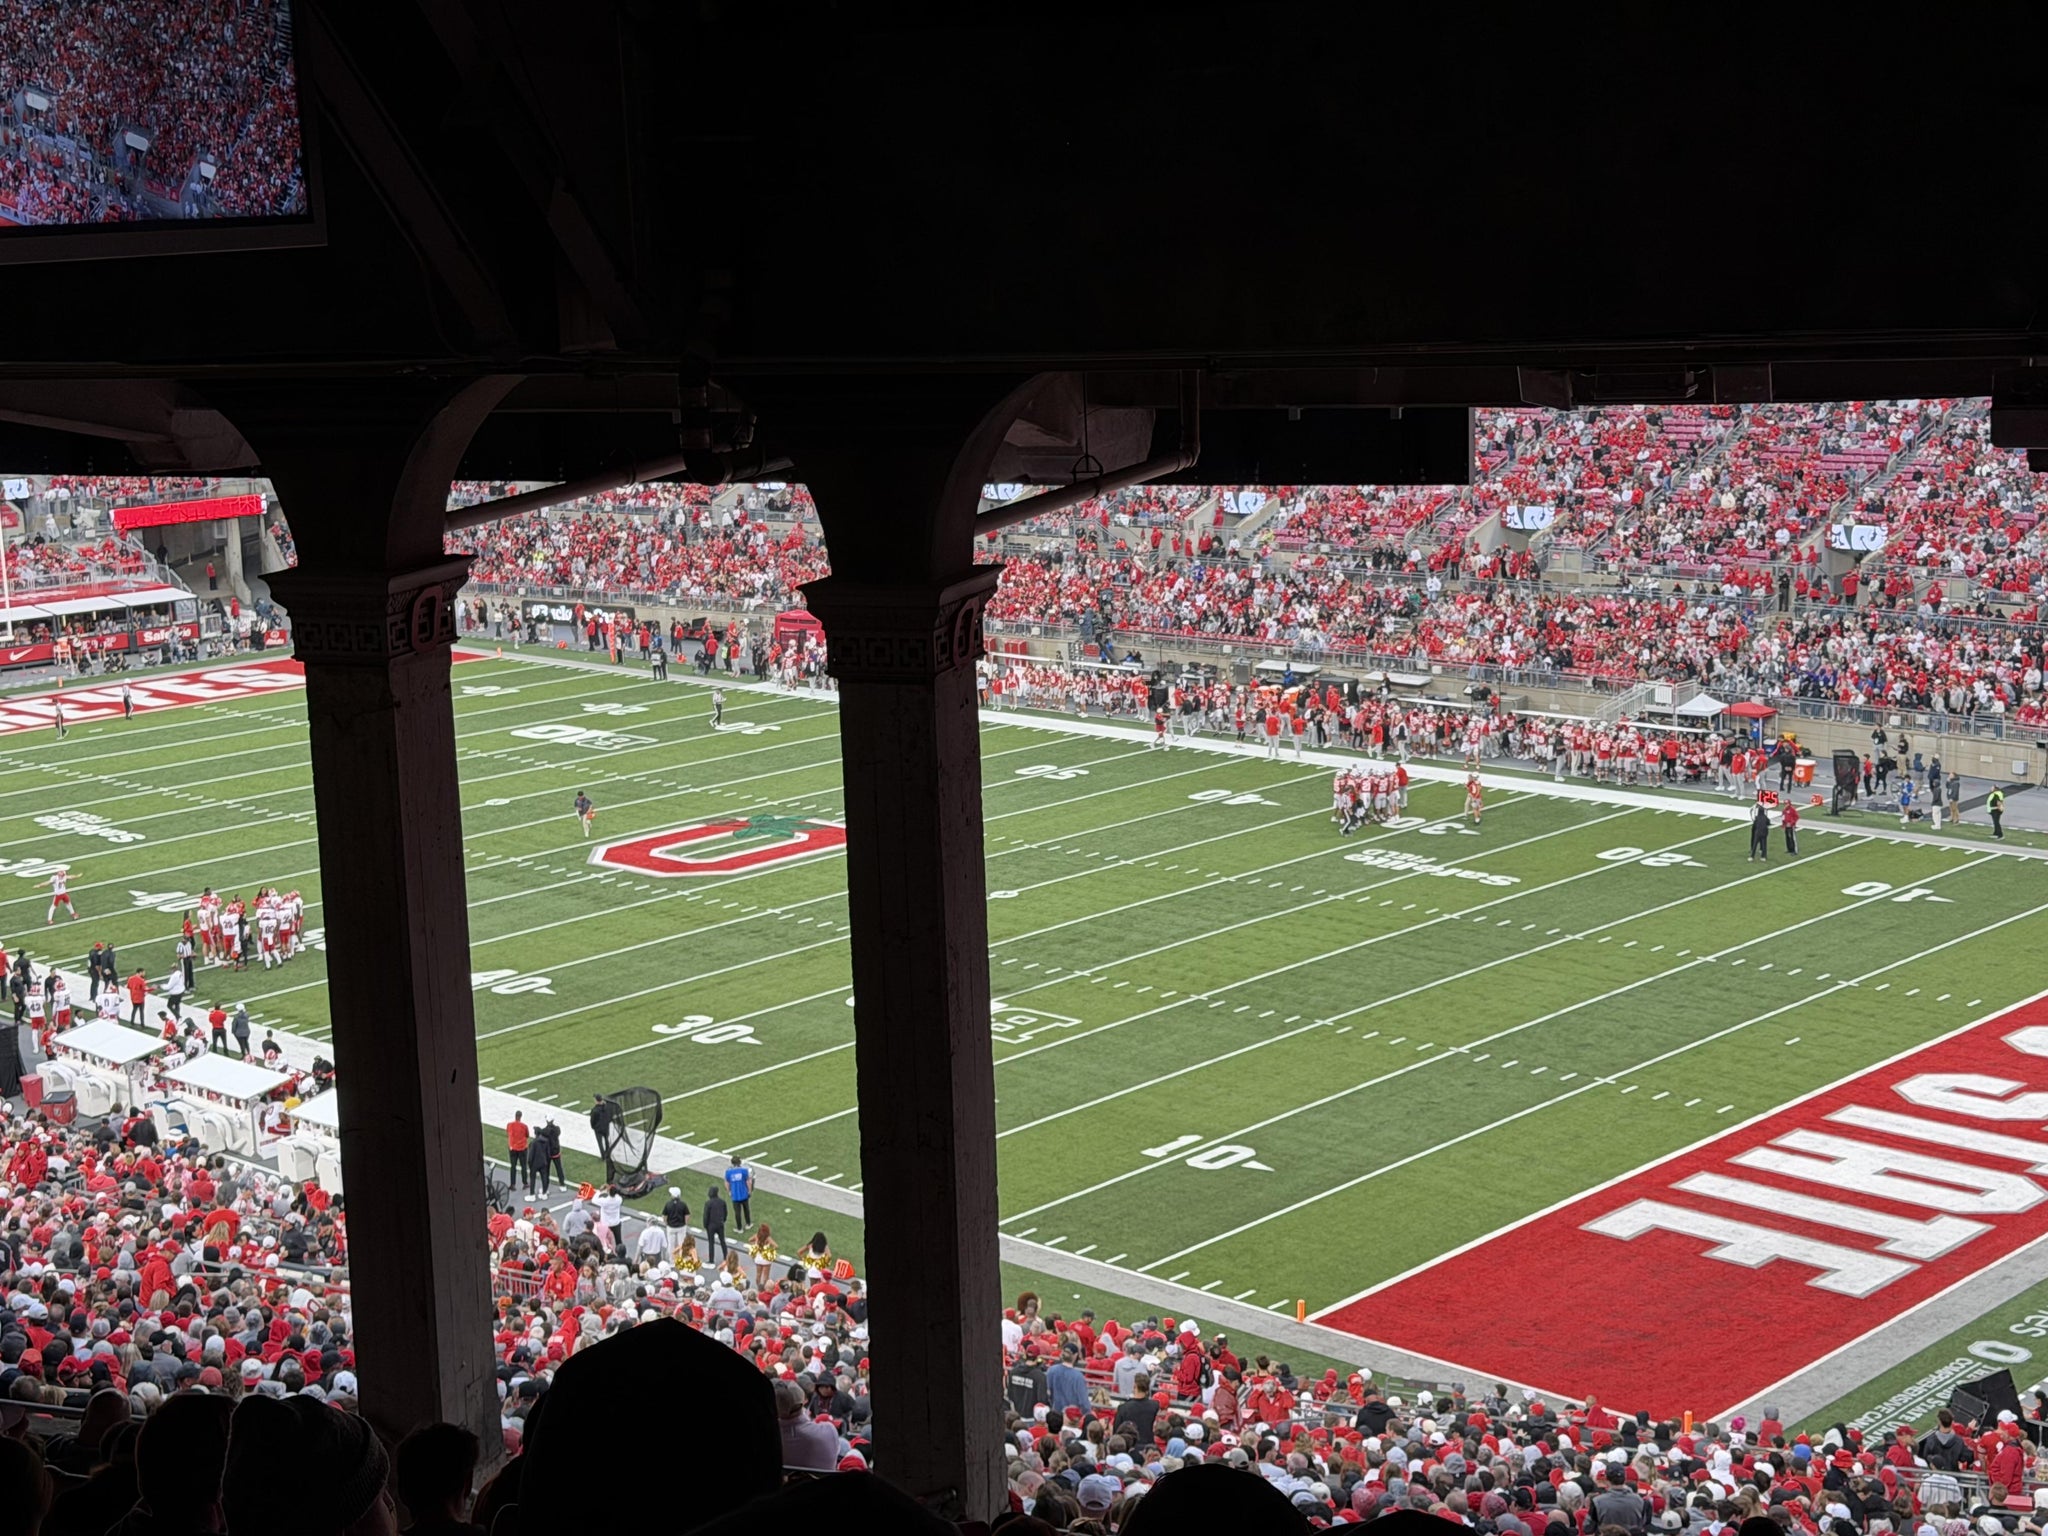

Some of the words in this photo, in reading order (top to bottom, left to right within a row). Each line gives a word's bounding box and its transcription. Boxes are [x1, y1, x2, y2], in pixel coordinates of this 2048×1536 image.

[1361, 849, 1438, 864] FIELD
[1595, 847, 1694, 868] 20
[1344, 853, 1522, 886] Safelite
[1842, 882, 1936, 902] 10
[652, 1015, 756, 1044] 30
[1141, 1134, 1259, 1170] 10
